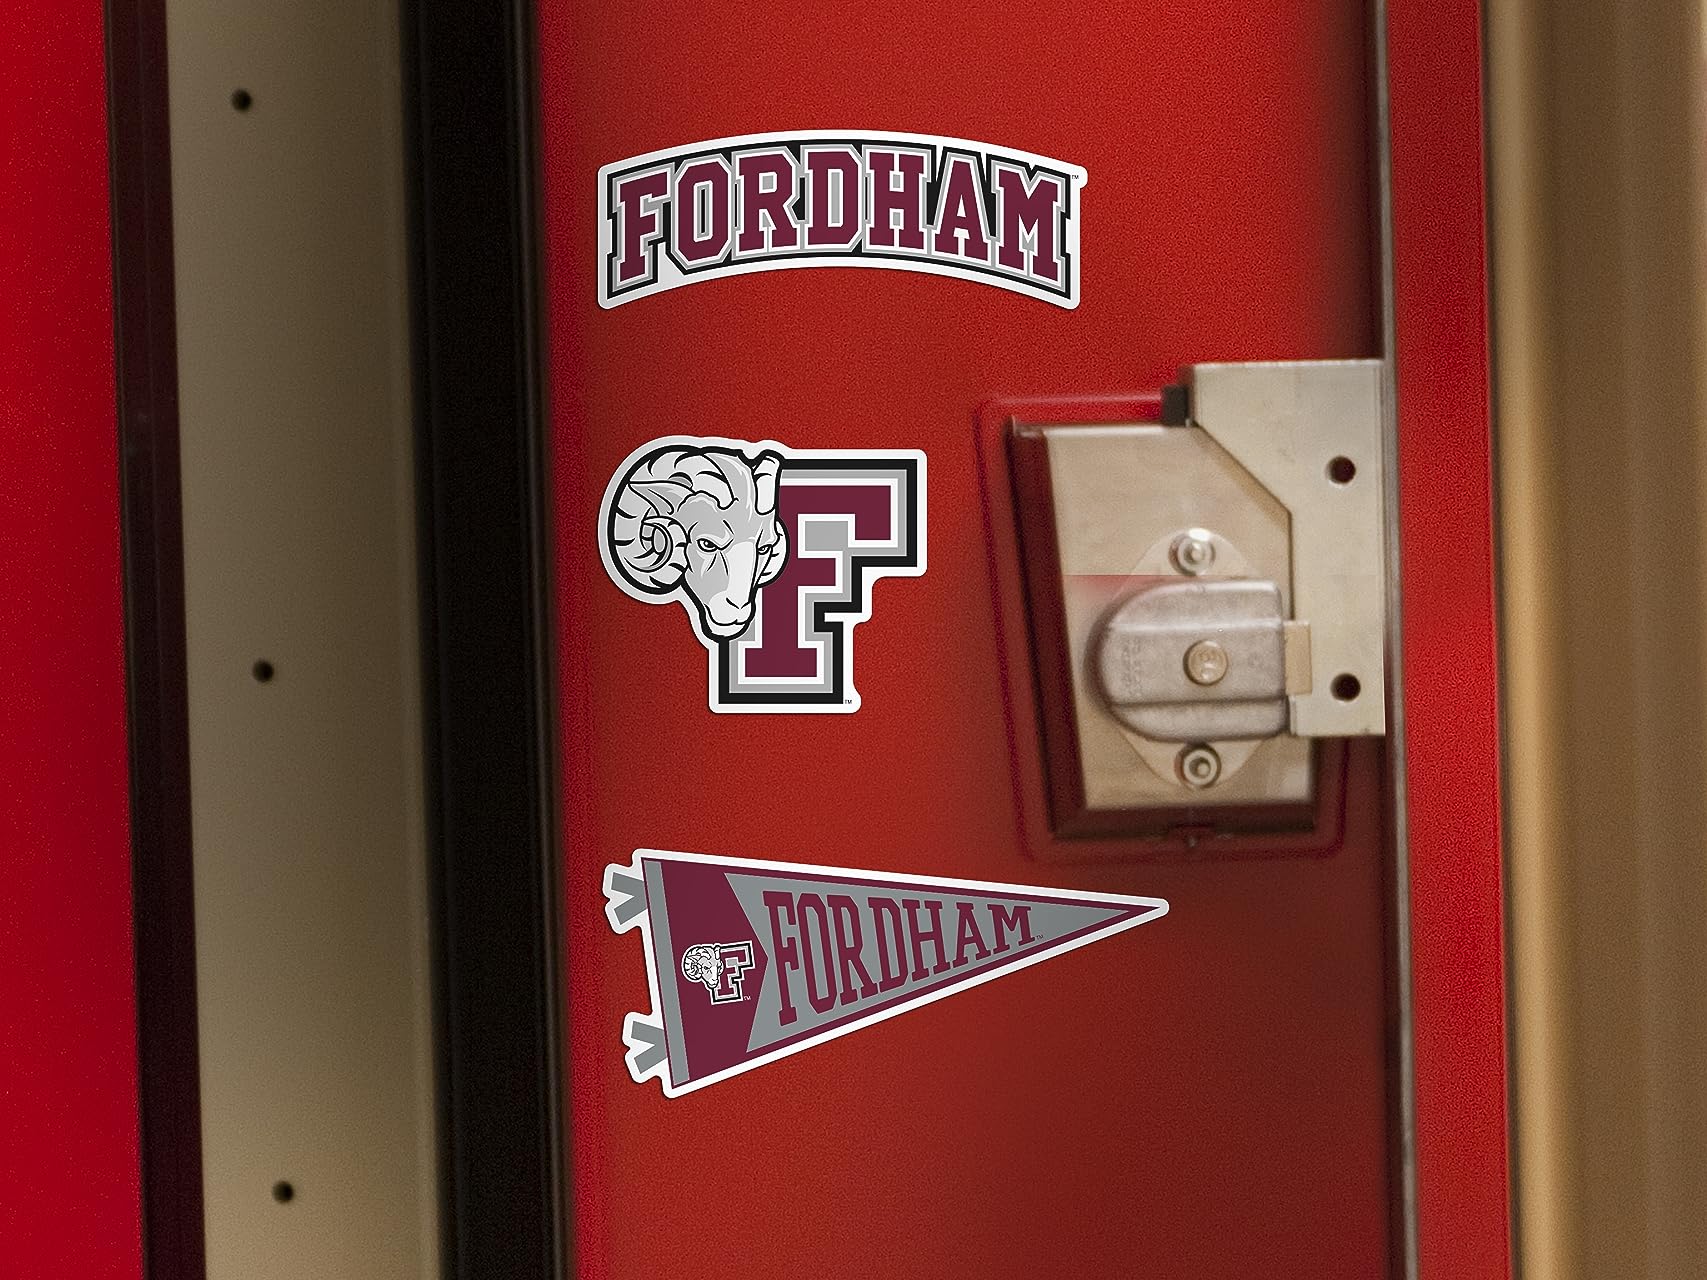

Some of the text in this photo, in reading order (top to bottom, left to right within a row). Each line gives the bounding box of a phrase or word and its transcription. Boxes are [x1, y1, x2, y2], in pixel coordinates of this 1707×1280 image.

[612, 144, 1066, 290] FORDHAM
[736, 476, 900, 686] F
[713, 944, 752, 1000] F
[763, 890, 1036, 1026] FORDHAM
